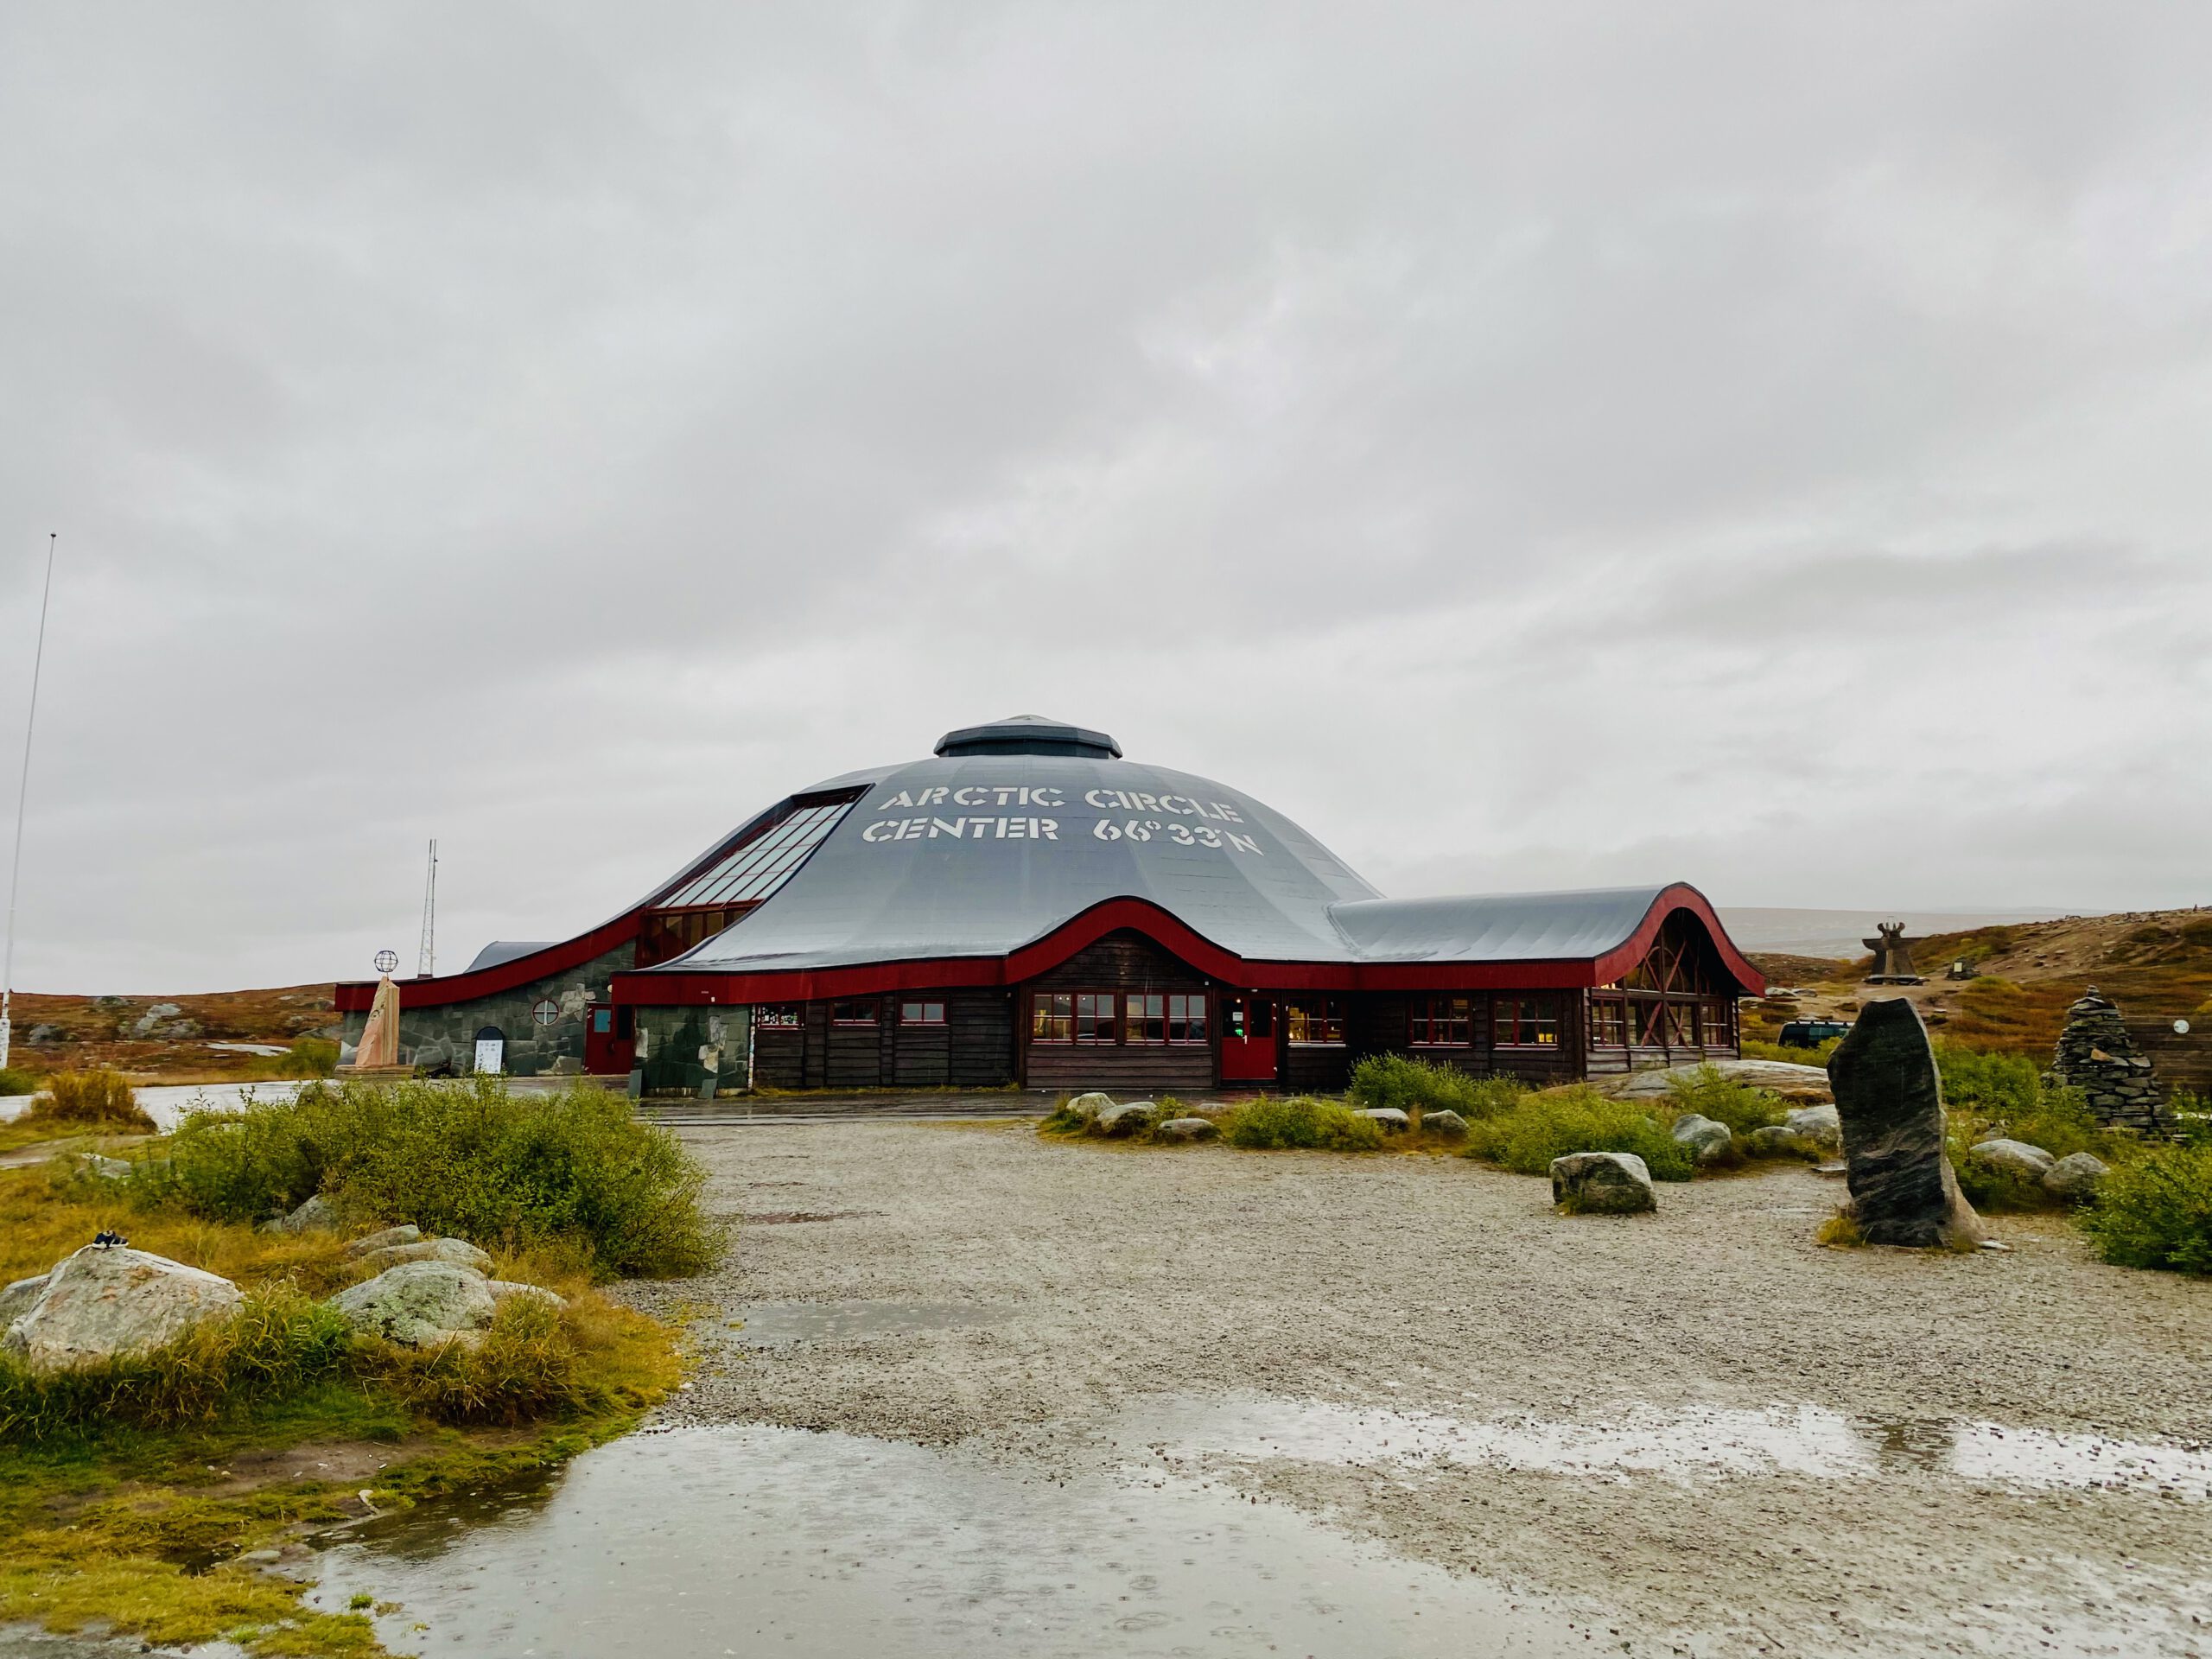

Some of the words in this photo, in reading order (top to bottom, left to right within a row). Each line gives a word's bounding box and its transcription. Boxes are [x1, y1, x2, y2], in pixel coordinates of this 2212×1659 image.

[877, 786, 1065, 810] ARCTIC
[1084, 789, 1246, 823] CIRCLE
[861, 817, 1059, 842] CENTER
